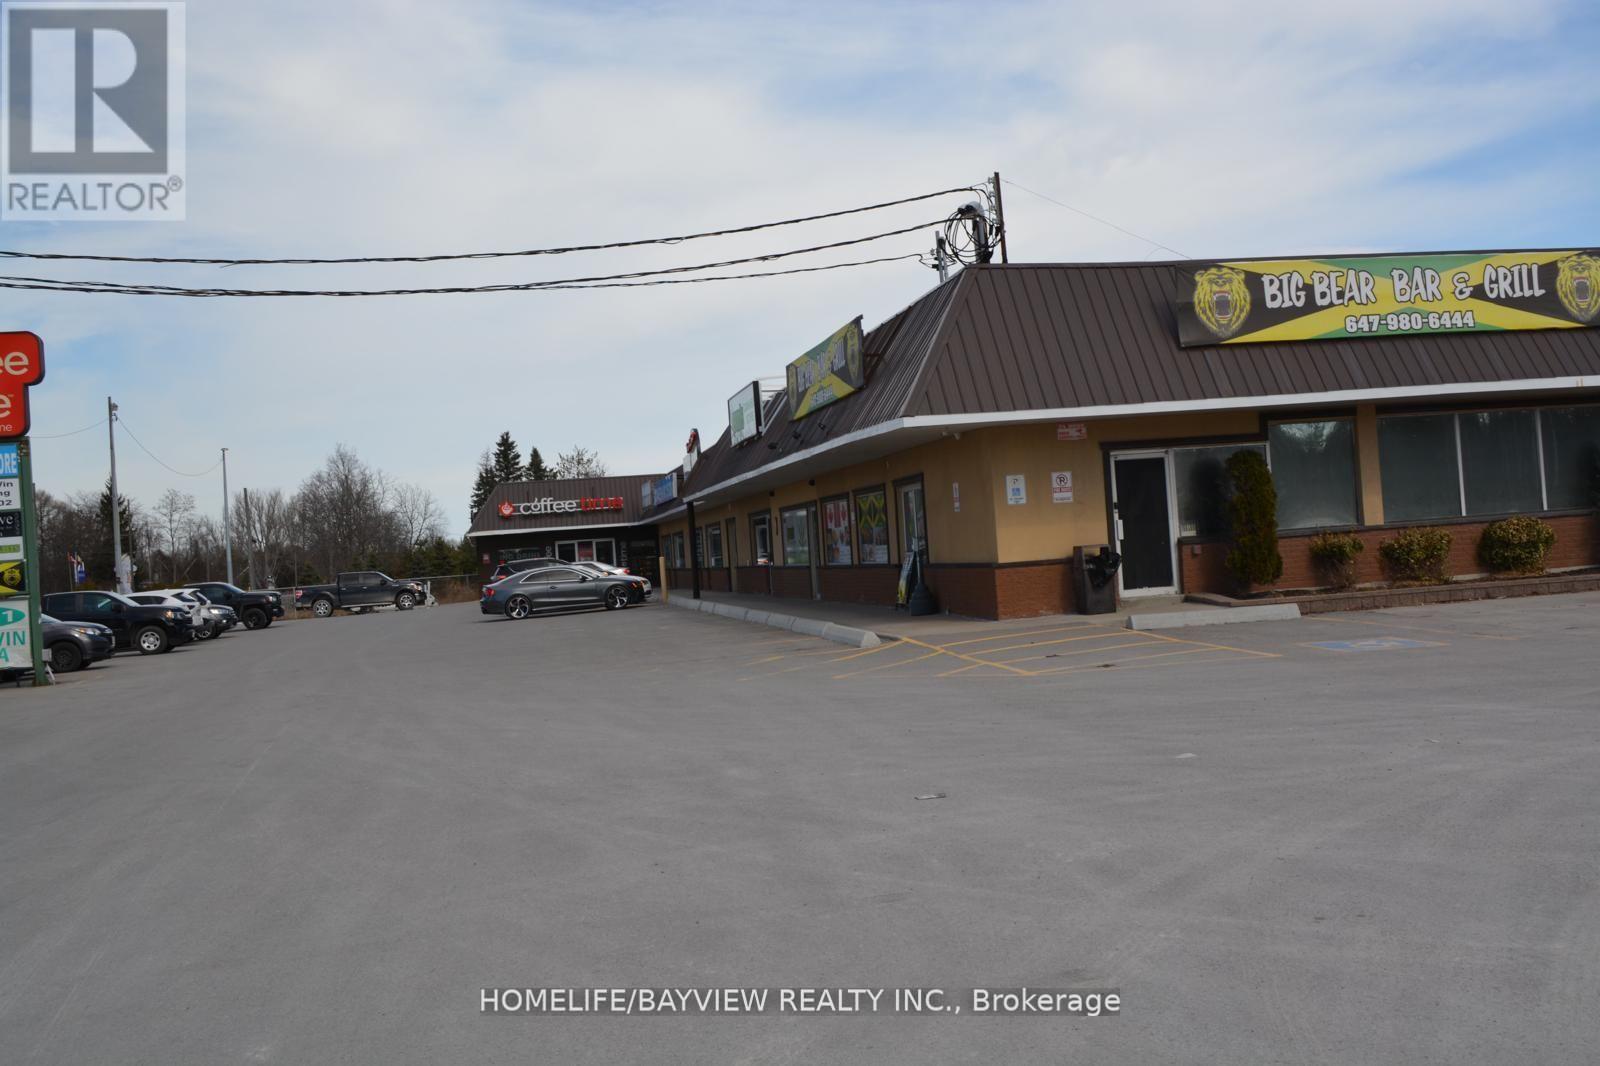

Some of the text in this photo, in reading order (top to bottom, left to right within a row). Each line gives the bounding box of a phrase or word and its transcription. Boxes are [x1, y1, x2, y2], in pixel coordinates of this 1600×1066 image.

[1261, 262, 1546, 309] BIG BEAR BAR & GRILL
[1344, 309, 1476, 333] 647-980-6444
[520, 497, 623, 514] coffee time
